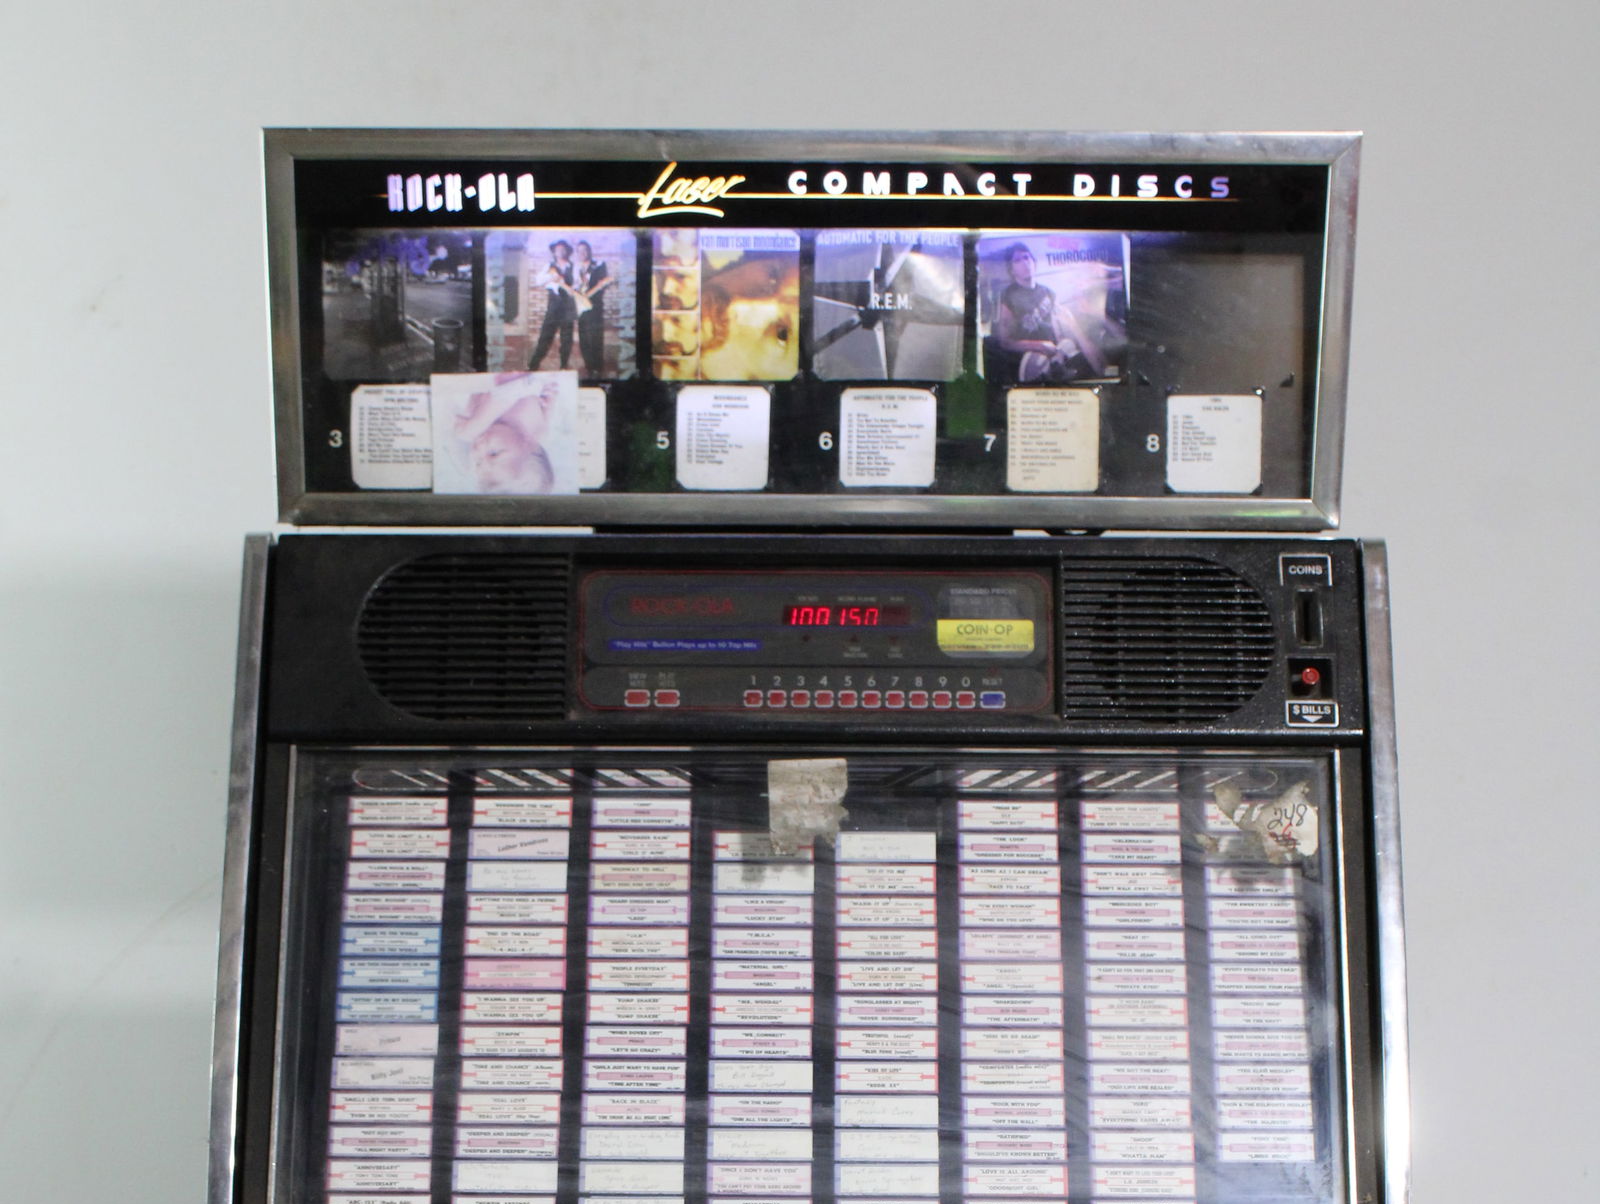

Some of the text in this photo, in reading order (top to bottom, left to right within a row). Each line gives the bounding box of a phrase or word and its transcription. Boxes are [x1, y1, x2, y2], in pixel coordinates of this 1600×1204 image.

[637, 160, 1230, 219] Laser COMPACT DISCS
[875, 231, 897, 245] FOR
[871, 293, 912, 310] R.E.M.
[328, 429, 343, 447] 3
[656, 431, 670, 449] 5
[819, 432, 833, 450] 6
[983, 433, 997, 452] 7
[1146, 434, 1160, 452] 8
[1289, 565, 1323, 575] COINS
[751, 675, 755, 686] 1
[773, 676, 781, 686] 2
[797, 676, 805, 687] 3
[819, 676, 828, 687] 4
[844, 676, 852, 687] 5
[867, 676, 876, 687] 6
[891, 676, 900, 687] 7
[915, 676, 923, 688] 8
[939, 677, 947, 688] 9
[962, 676, 971, 688] 0
[1293, 705, 1332, 715] $ BILLS
[1267, 804, 1307, 830] 248
